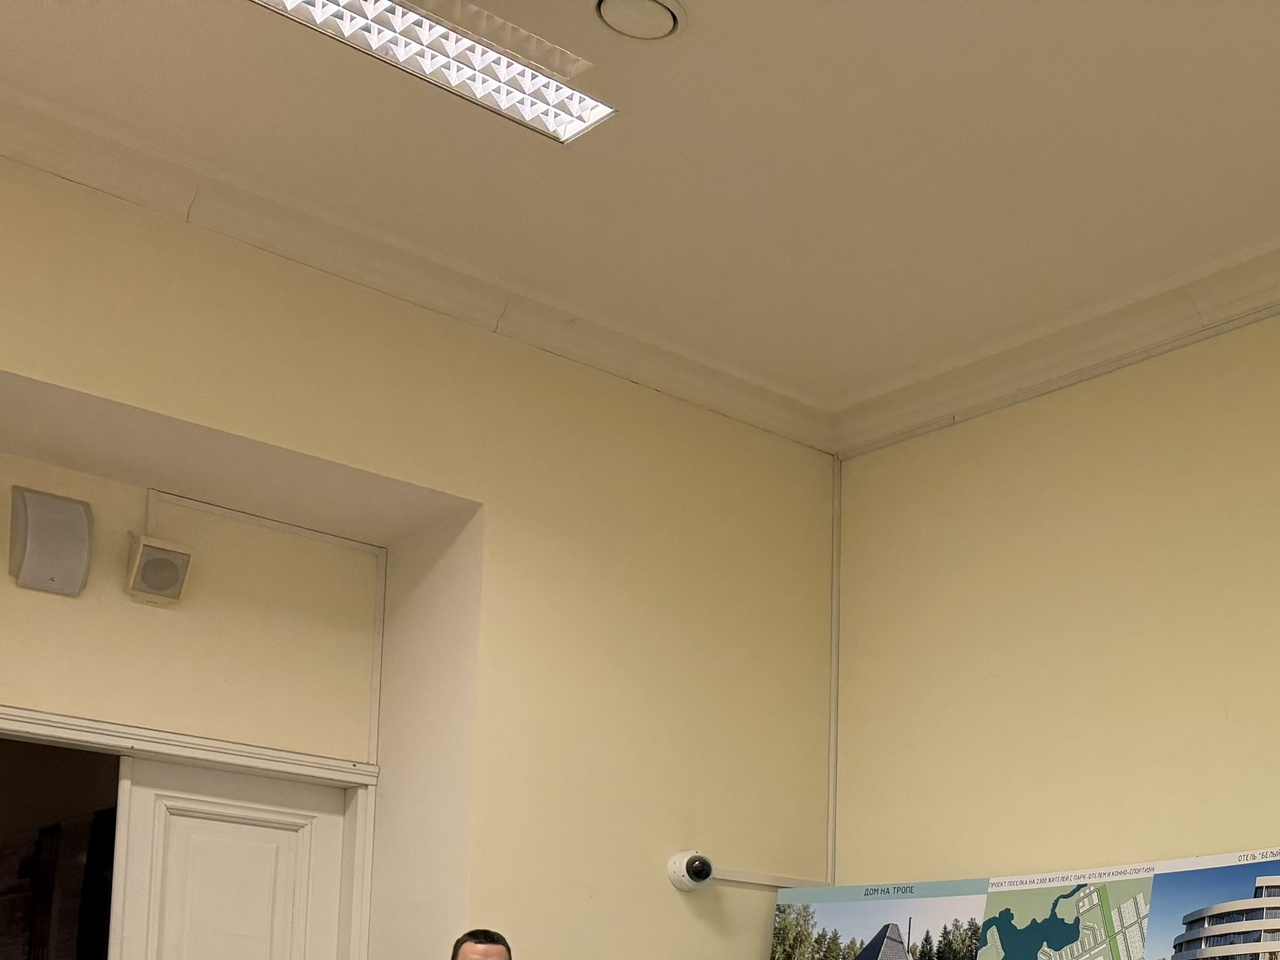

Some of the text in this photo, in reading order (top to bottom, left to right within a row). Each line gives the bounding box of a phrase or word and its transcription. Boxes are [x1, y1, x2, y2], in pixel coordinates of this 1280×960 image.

[1238, 853, 1257, 862] ОТЕЛЬ
[989, 880, 1007, 888] ПРОЕКТ
[1036, 877, 1047, 885] 2300
[1048, 875, 1069, 883] ЖИТЕЛЕЙ
[864, 885, 914, 897] ДОМ НА ТРОПЕ
